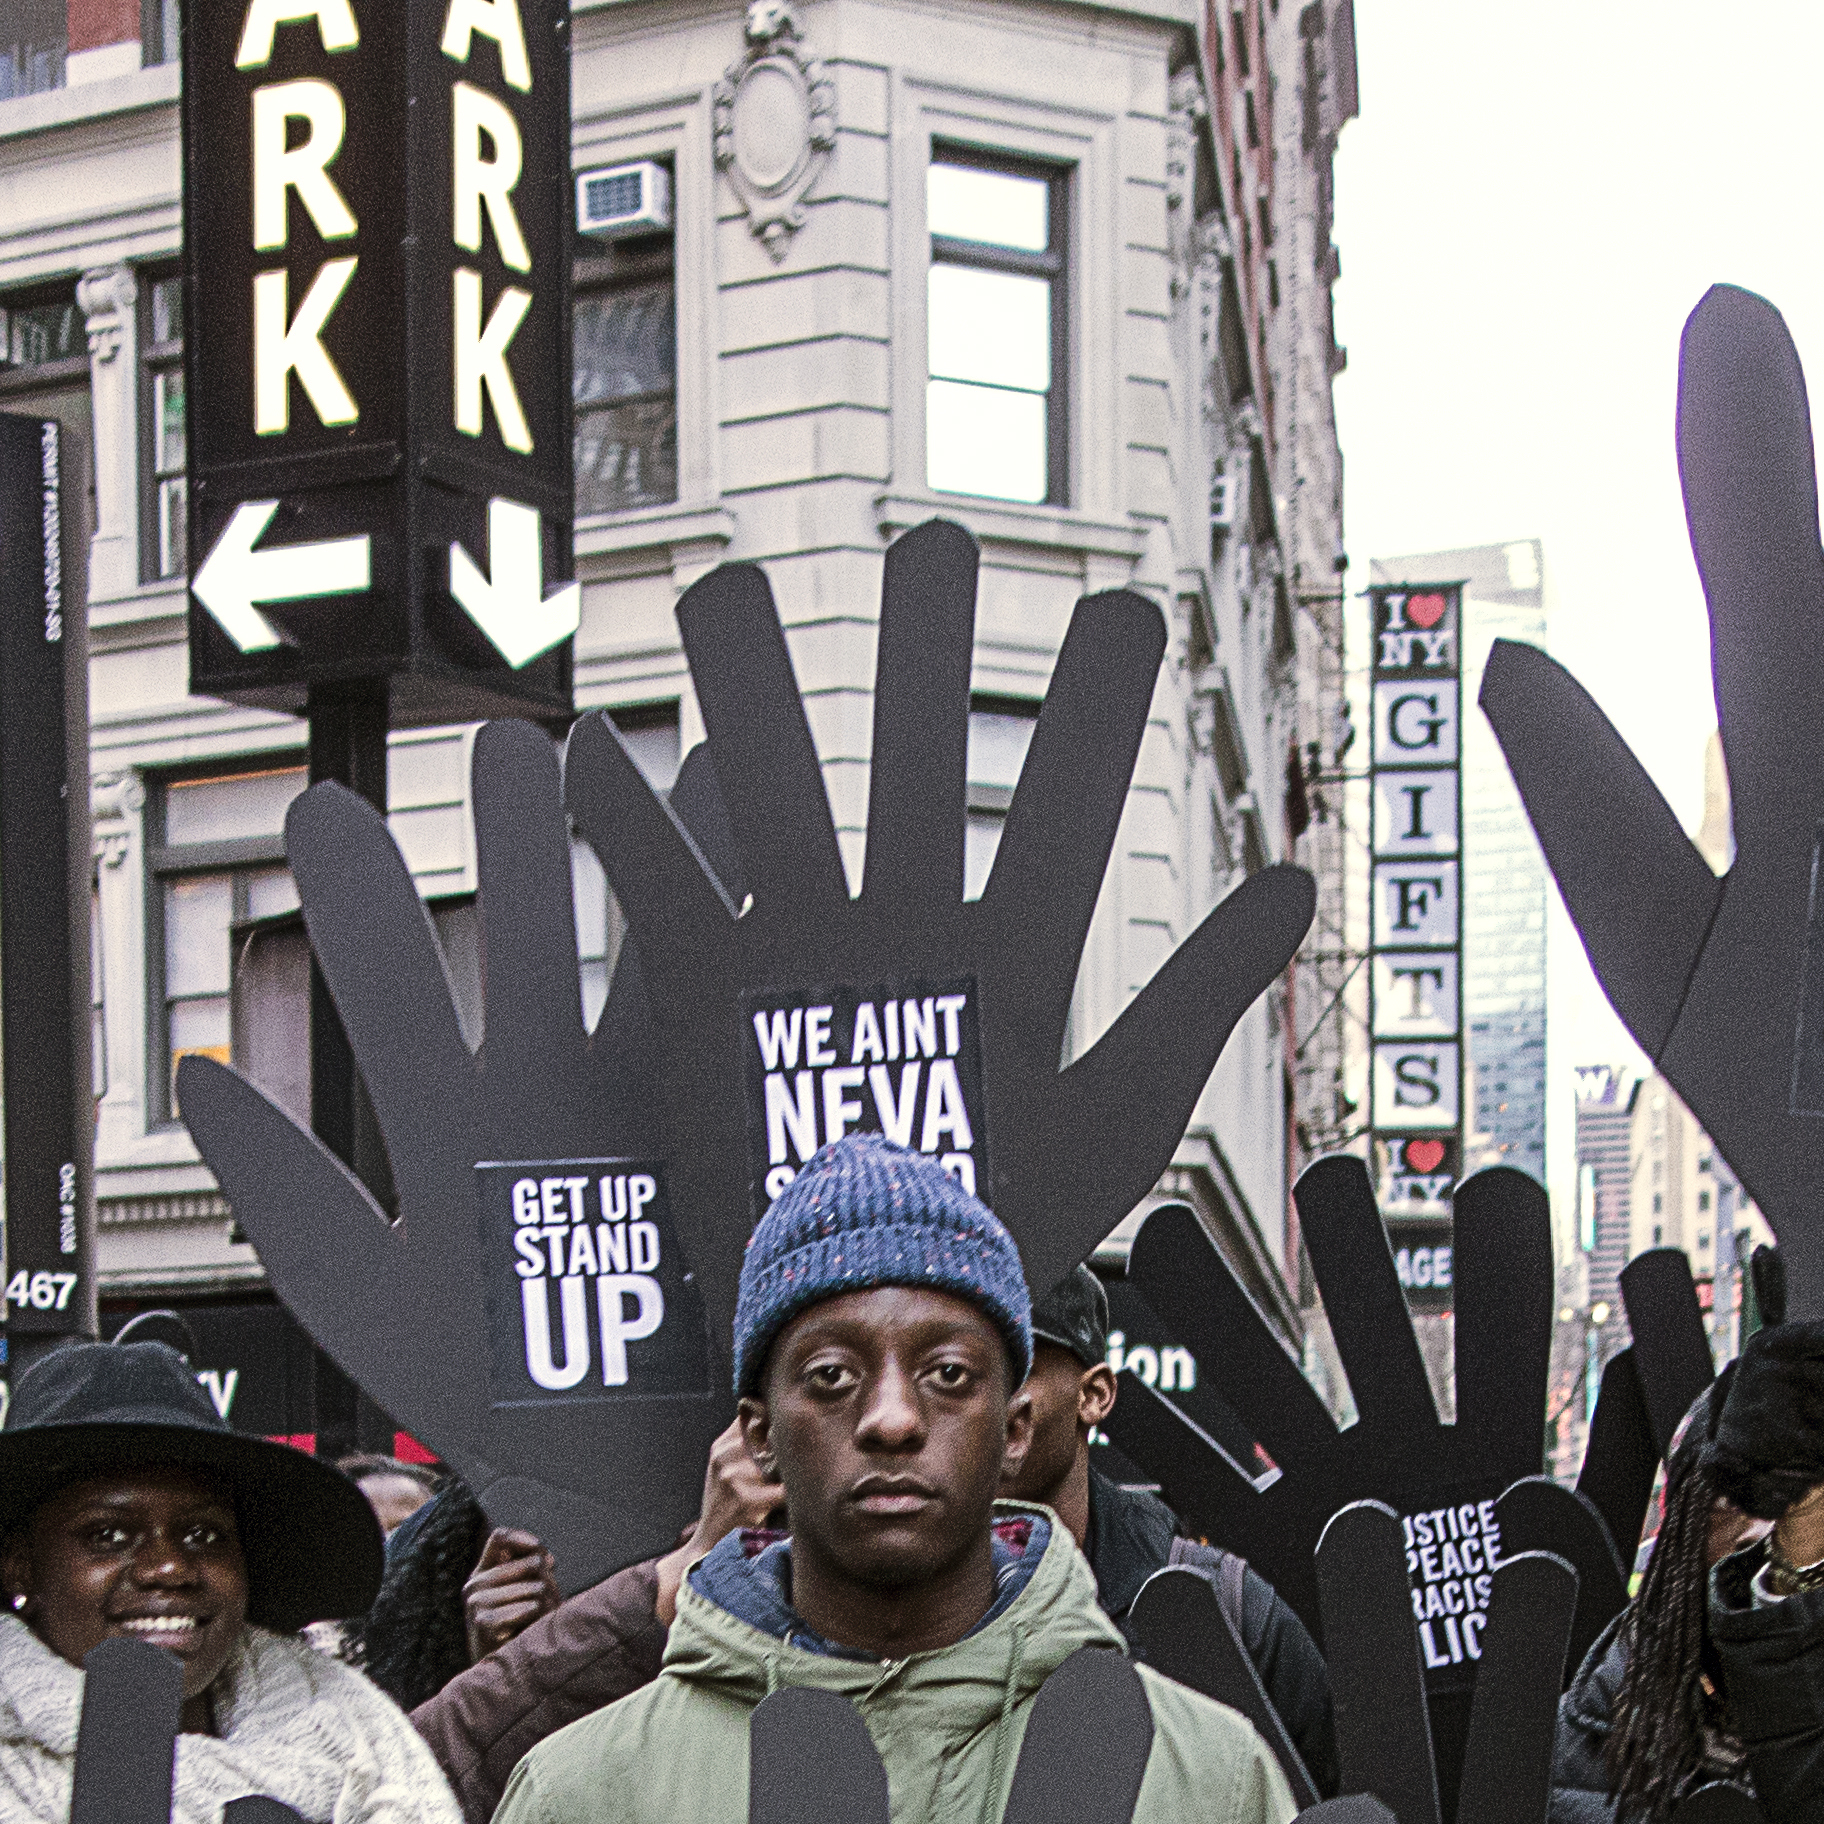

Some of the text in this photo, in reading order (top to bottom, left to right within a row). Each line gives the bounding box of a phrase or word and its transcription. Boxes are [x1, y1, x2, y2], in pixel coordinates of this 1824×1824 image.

[1379, 630, 1451, 668] NY
[1388, 693, 1448, 1109] GIFTS
[753, 994, 966, 1072] WE AINT
[763, 1059, 974, 1165] NEVA
[512, 1173, 658, 1226] GET UP
[514, 1221, 661, 1278] STAND
[1395, 1246, 1452, 1288] AGE
[6, 1269, 77, 1311] 467
[522, 1272, 664, 1391] UP
[1107, 1329, 1196, 1392] ion
[1419, 1611, 1487, 1669] LIC
